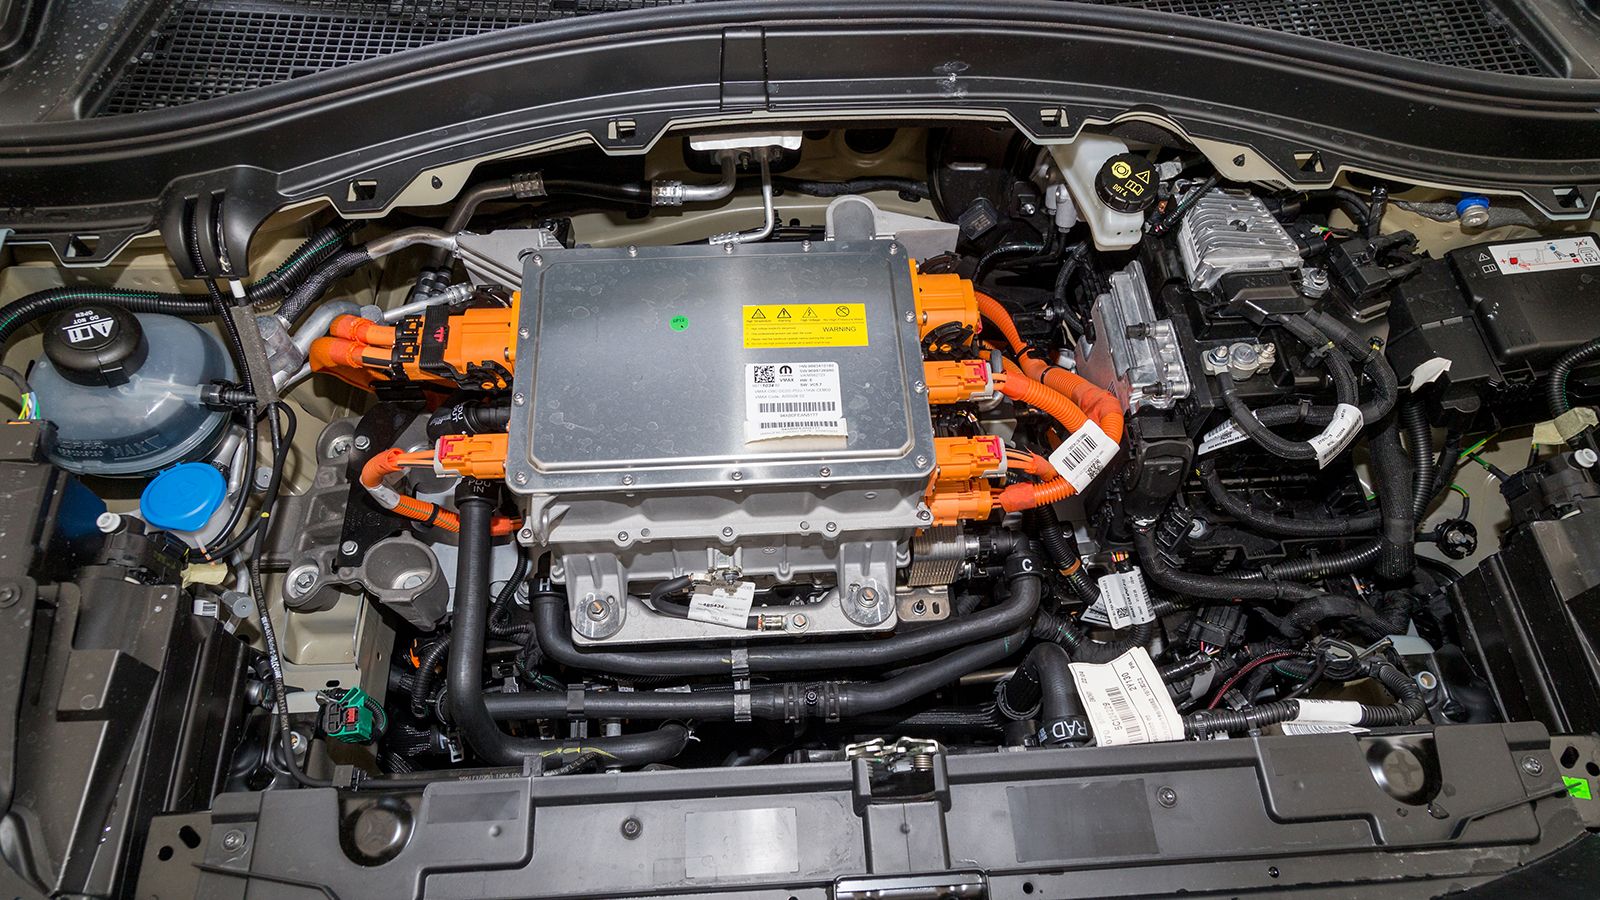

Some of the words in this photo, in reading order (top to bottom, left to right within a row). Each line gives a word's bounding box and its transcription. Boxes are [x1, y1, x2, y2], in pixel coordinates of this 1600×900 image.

[1112, 184, 1124, 193] DOT
[1022, 558, 1033, 572] C
[539, 578, 550, 591] H
[1052, 720, 1088, 738] RAD
